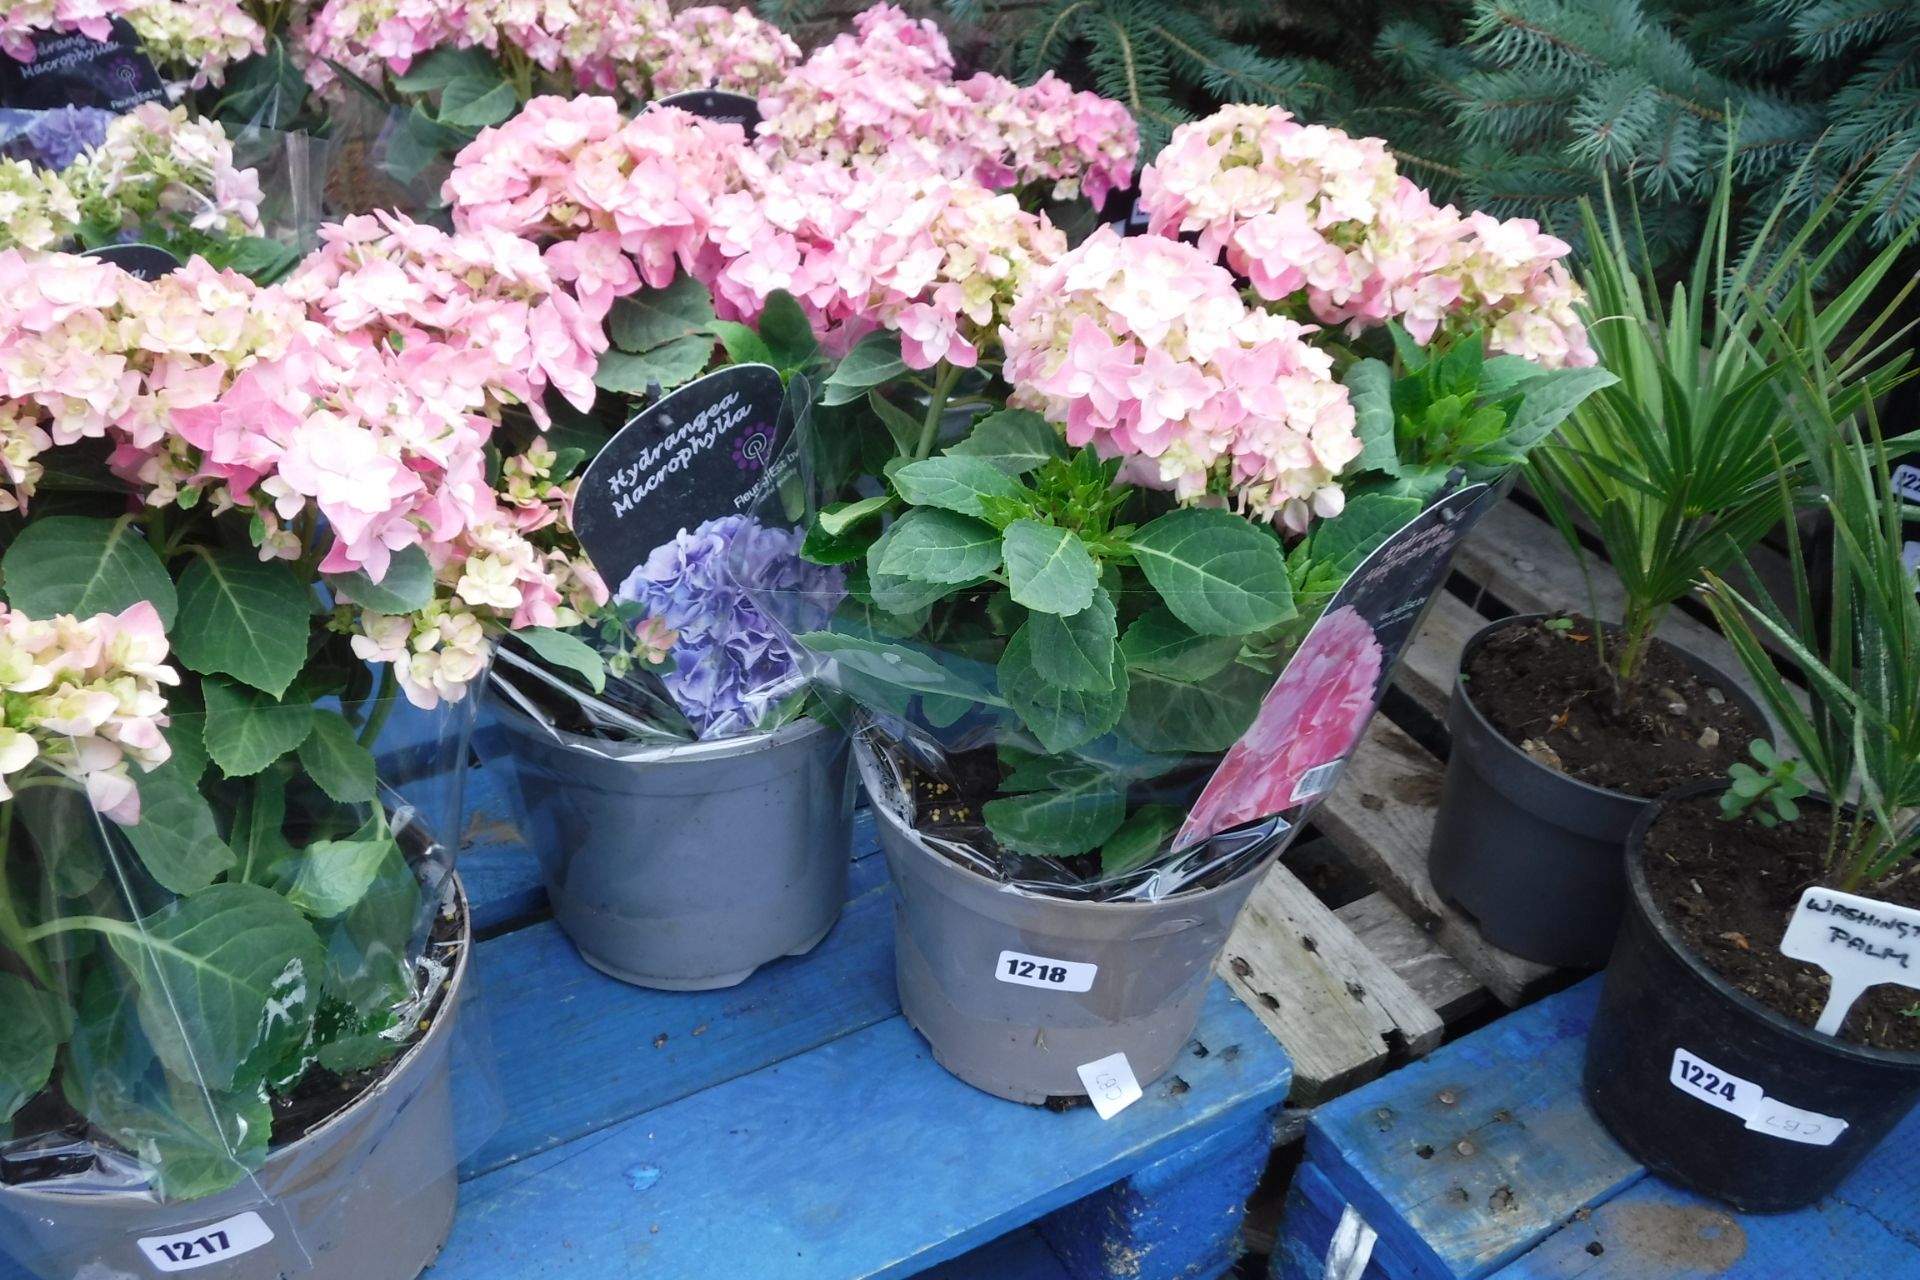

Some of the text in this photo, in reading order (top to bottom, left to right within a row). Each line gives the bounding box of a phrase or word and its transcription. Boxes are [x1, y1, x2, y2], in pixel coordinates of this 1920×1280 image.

[18, 40, 120, 80] Macrophylla
[37, 32, 87, 57] drang
[607, 391, 740, 496] Hydrangea
[611, 403, 753, 519] Macrophylla
[1828, 926, 1910, 969] PALM
[1006, 958, 1068, 983] 1218
[1679, 1058, 1737, 1102] 1224
[155, 1229, 231, 1263] 1217
